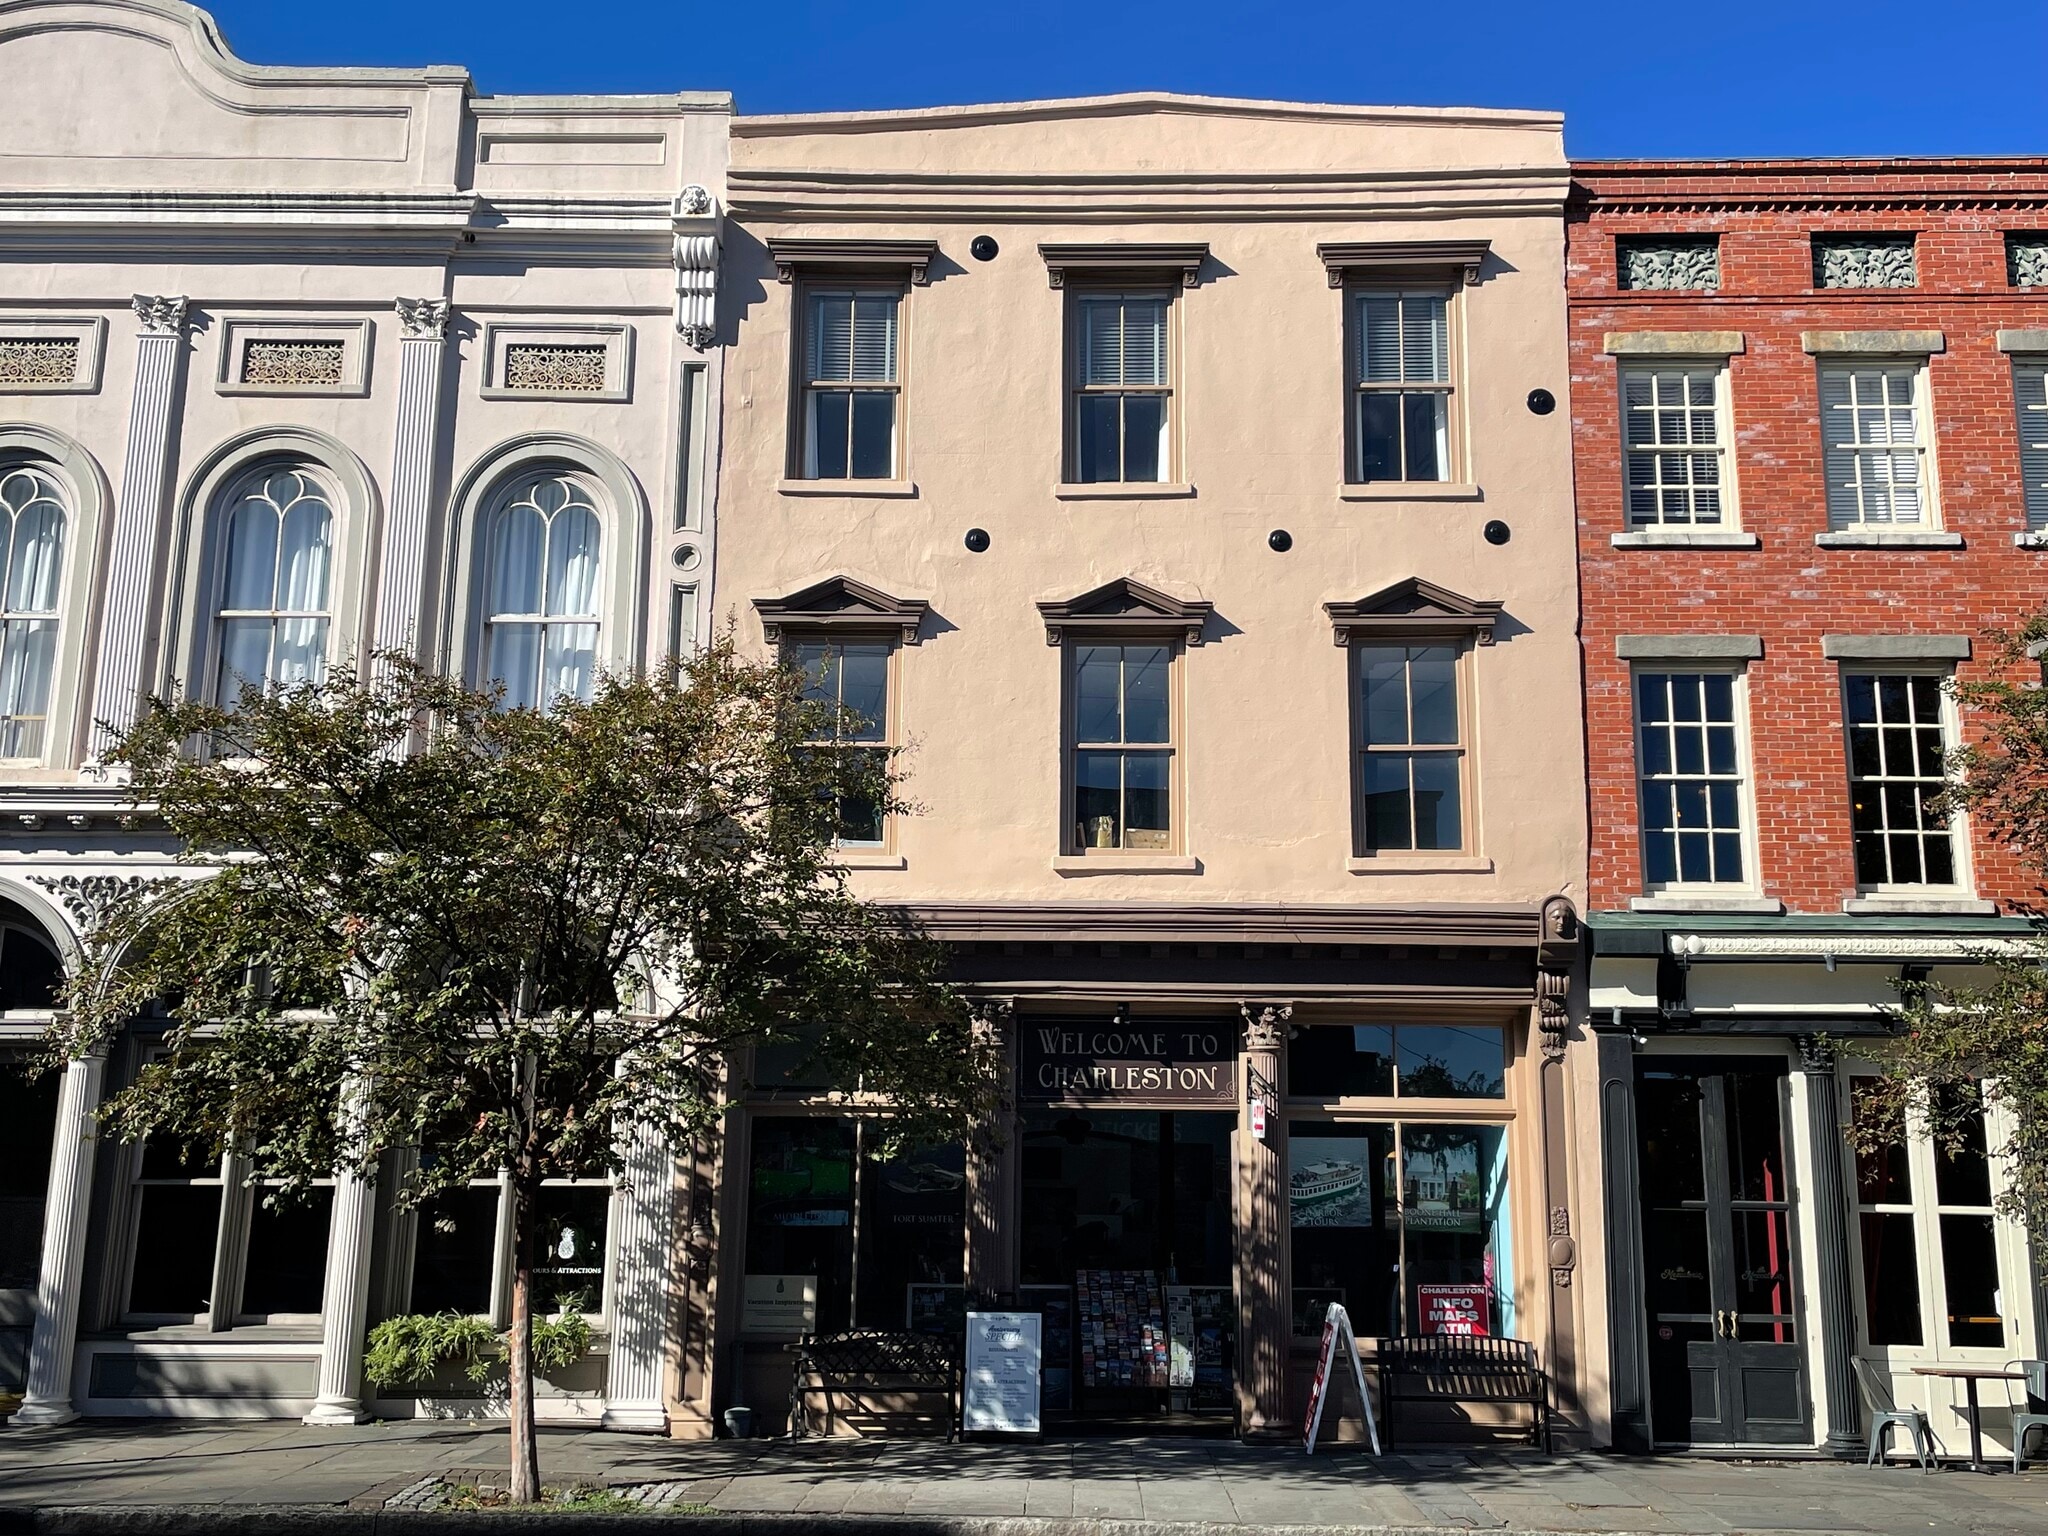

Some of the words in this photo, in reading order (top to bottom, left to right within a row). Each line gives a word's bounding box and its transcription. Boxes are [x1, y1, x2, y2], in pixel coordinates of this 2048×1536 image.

[1037, 1026, 1168, 1056] WELCOME
[1180, 1033, 1218, 1056] TO
[1038, 1063, 1218, 1091] CHARLESTON
[1096, 1121, 1182, 1141] TICKES
[1305, 1208, 1344, 1217] HARBOR
[1404, 1208, 1437, 1217] BOONE
[1439, 1209, 1461, 1218] HALL
[918, 1214, 955, 1224] SUMTER
[1309, 1218, 1339, 1226] TOURS
[1405, 1218, 1462, 1227] PLANTATION
[1421, 1287, 1485, 1295] CHARLESTON
[1432, 1297, 1474, 1309] INFO
[1428, 1310, 1480, 1322] MAPS
[1436, 1323, 1472, 1335] ATM
[985, 1332, 1024, 1341] SPECIAL
